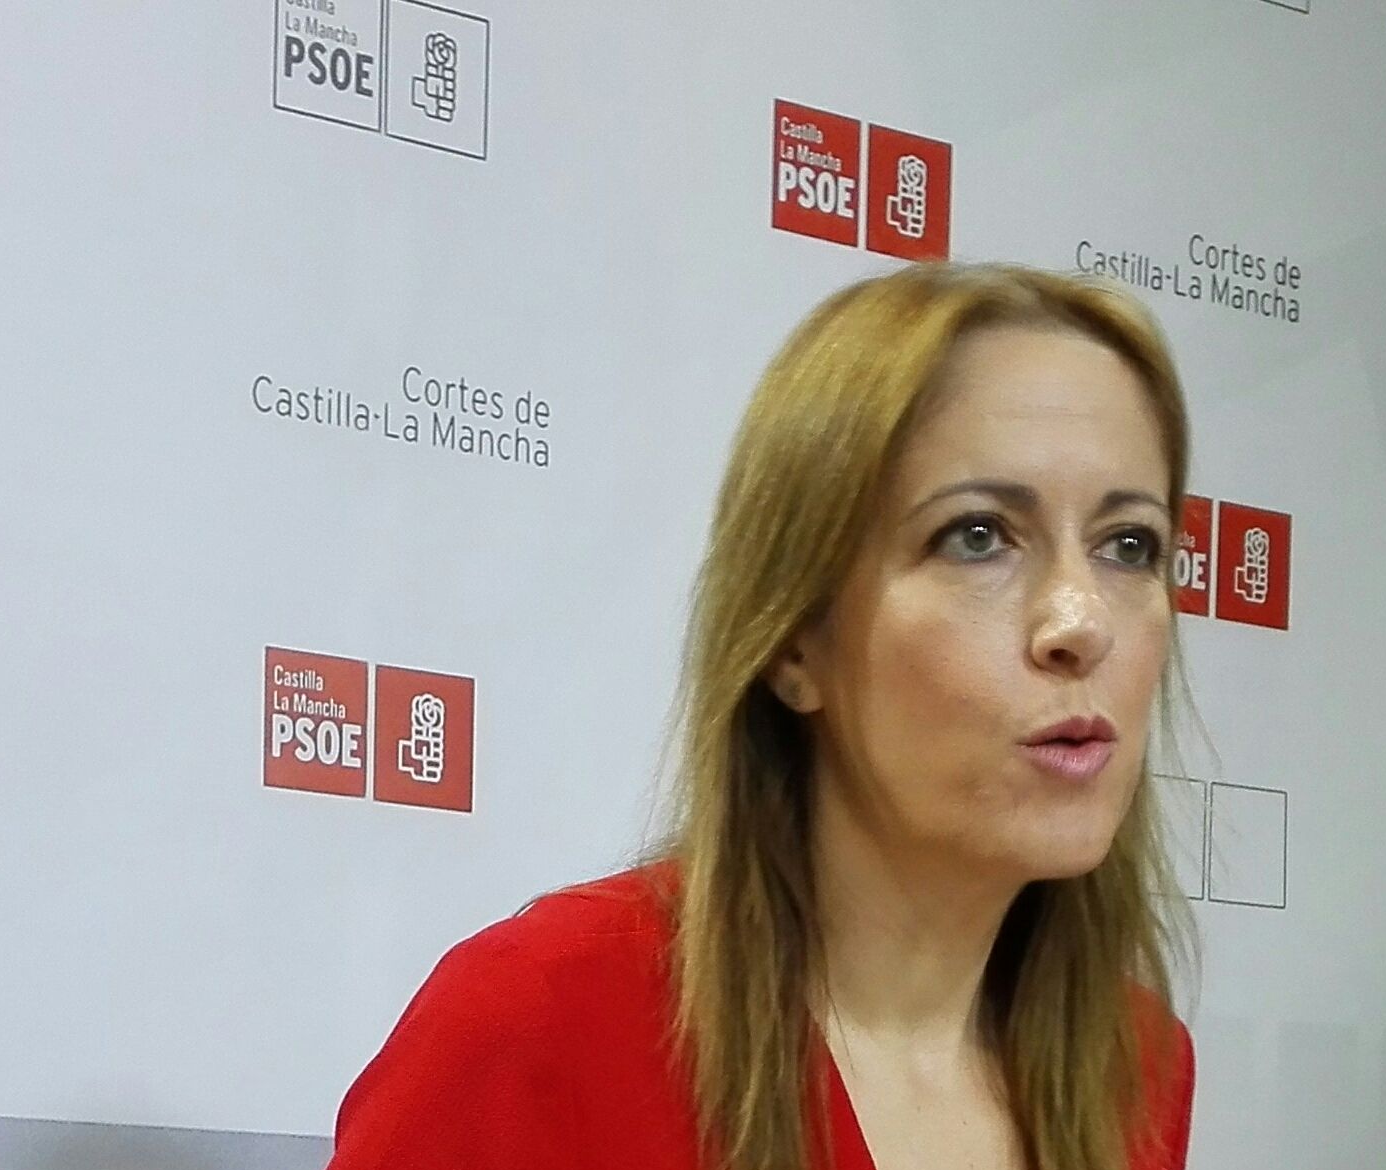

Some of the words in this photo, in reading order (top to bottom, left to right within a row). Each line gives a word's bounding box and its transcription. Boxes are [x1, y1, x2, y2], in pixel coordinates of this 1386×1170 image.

[285, 11, 301, 32] La
[305, 15, 358, 46] Mancha
[286, 0, 335, 16] astilla
[284, 35, 374, 97] PSOE
[780, 116, 823, 144] Castilla
[779, 139, 794, 160] La
[797, 144, 842, 172] Mancha
[778, 161, 855, 218] PSOE
[1188, 234, 1266, 281] Cortes
[1274, 256, 1302, 290] de
[1211, 273, 1301, 323] Mancha
[402, 366, 504, 419] Cortes
[515, 390, 550, 428] de
[432, 411, 549, 467] Mancha
[1174, 548, 1207, 590] OE
[273, 664, 324, 691] Castilla
[273, 690, 289, 711] La
[293, 693, 346, 719] Mancha
[271, 713, 362, 768] PSOE
